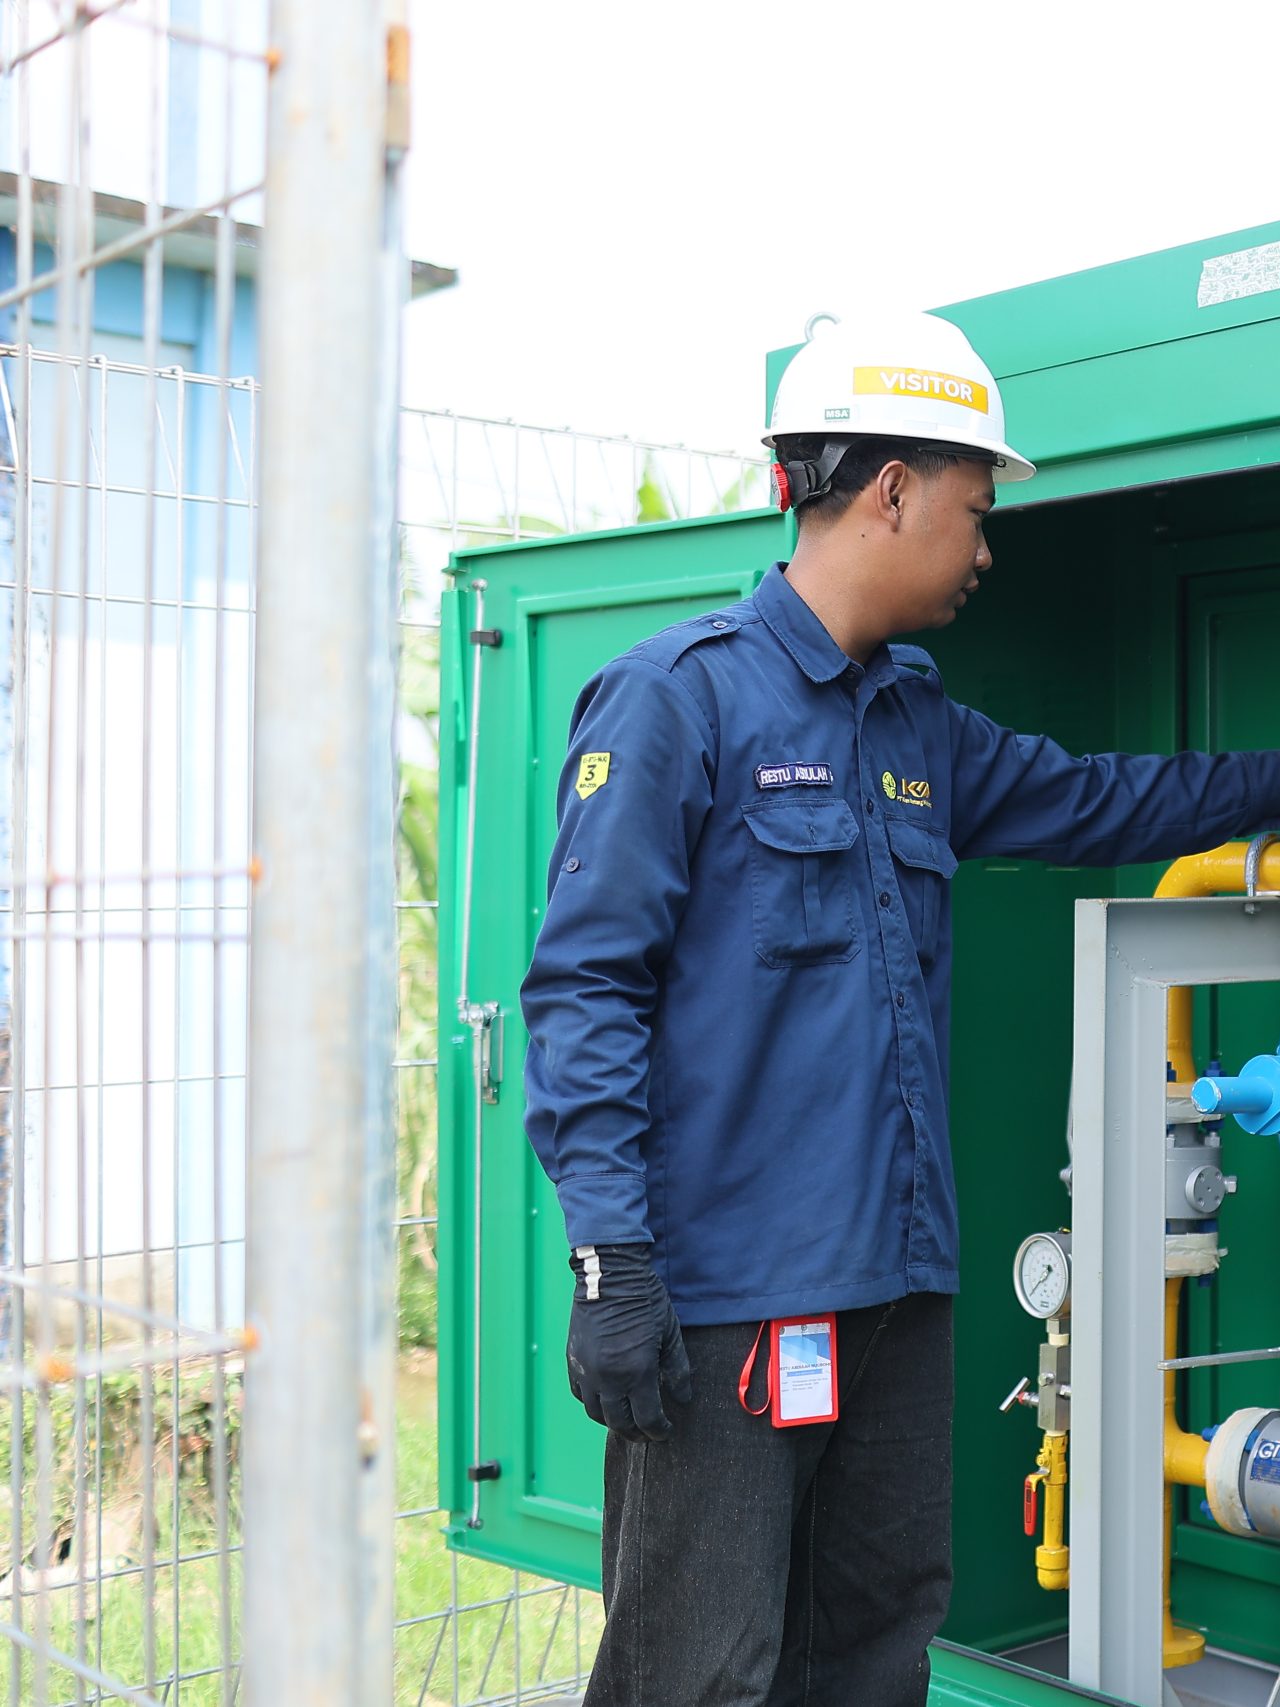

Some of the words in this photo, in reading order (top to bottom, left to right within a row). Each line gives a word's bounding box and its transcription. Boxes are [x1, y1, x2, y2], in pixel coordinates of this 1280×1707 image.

[880, 371, 973, 403] VISITOR
[826, 409, 848, 418] MSA
[584, 764, 597, 782] 3
[760, 768, 791, 785] RESTU
